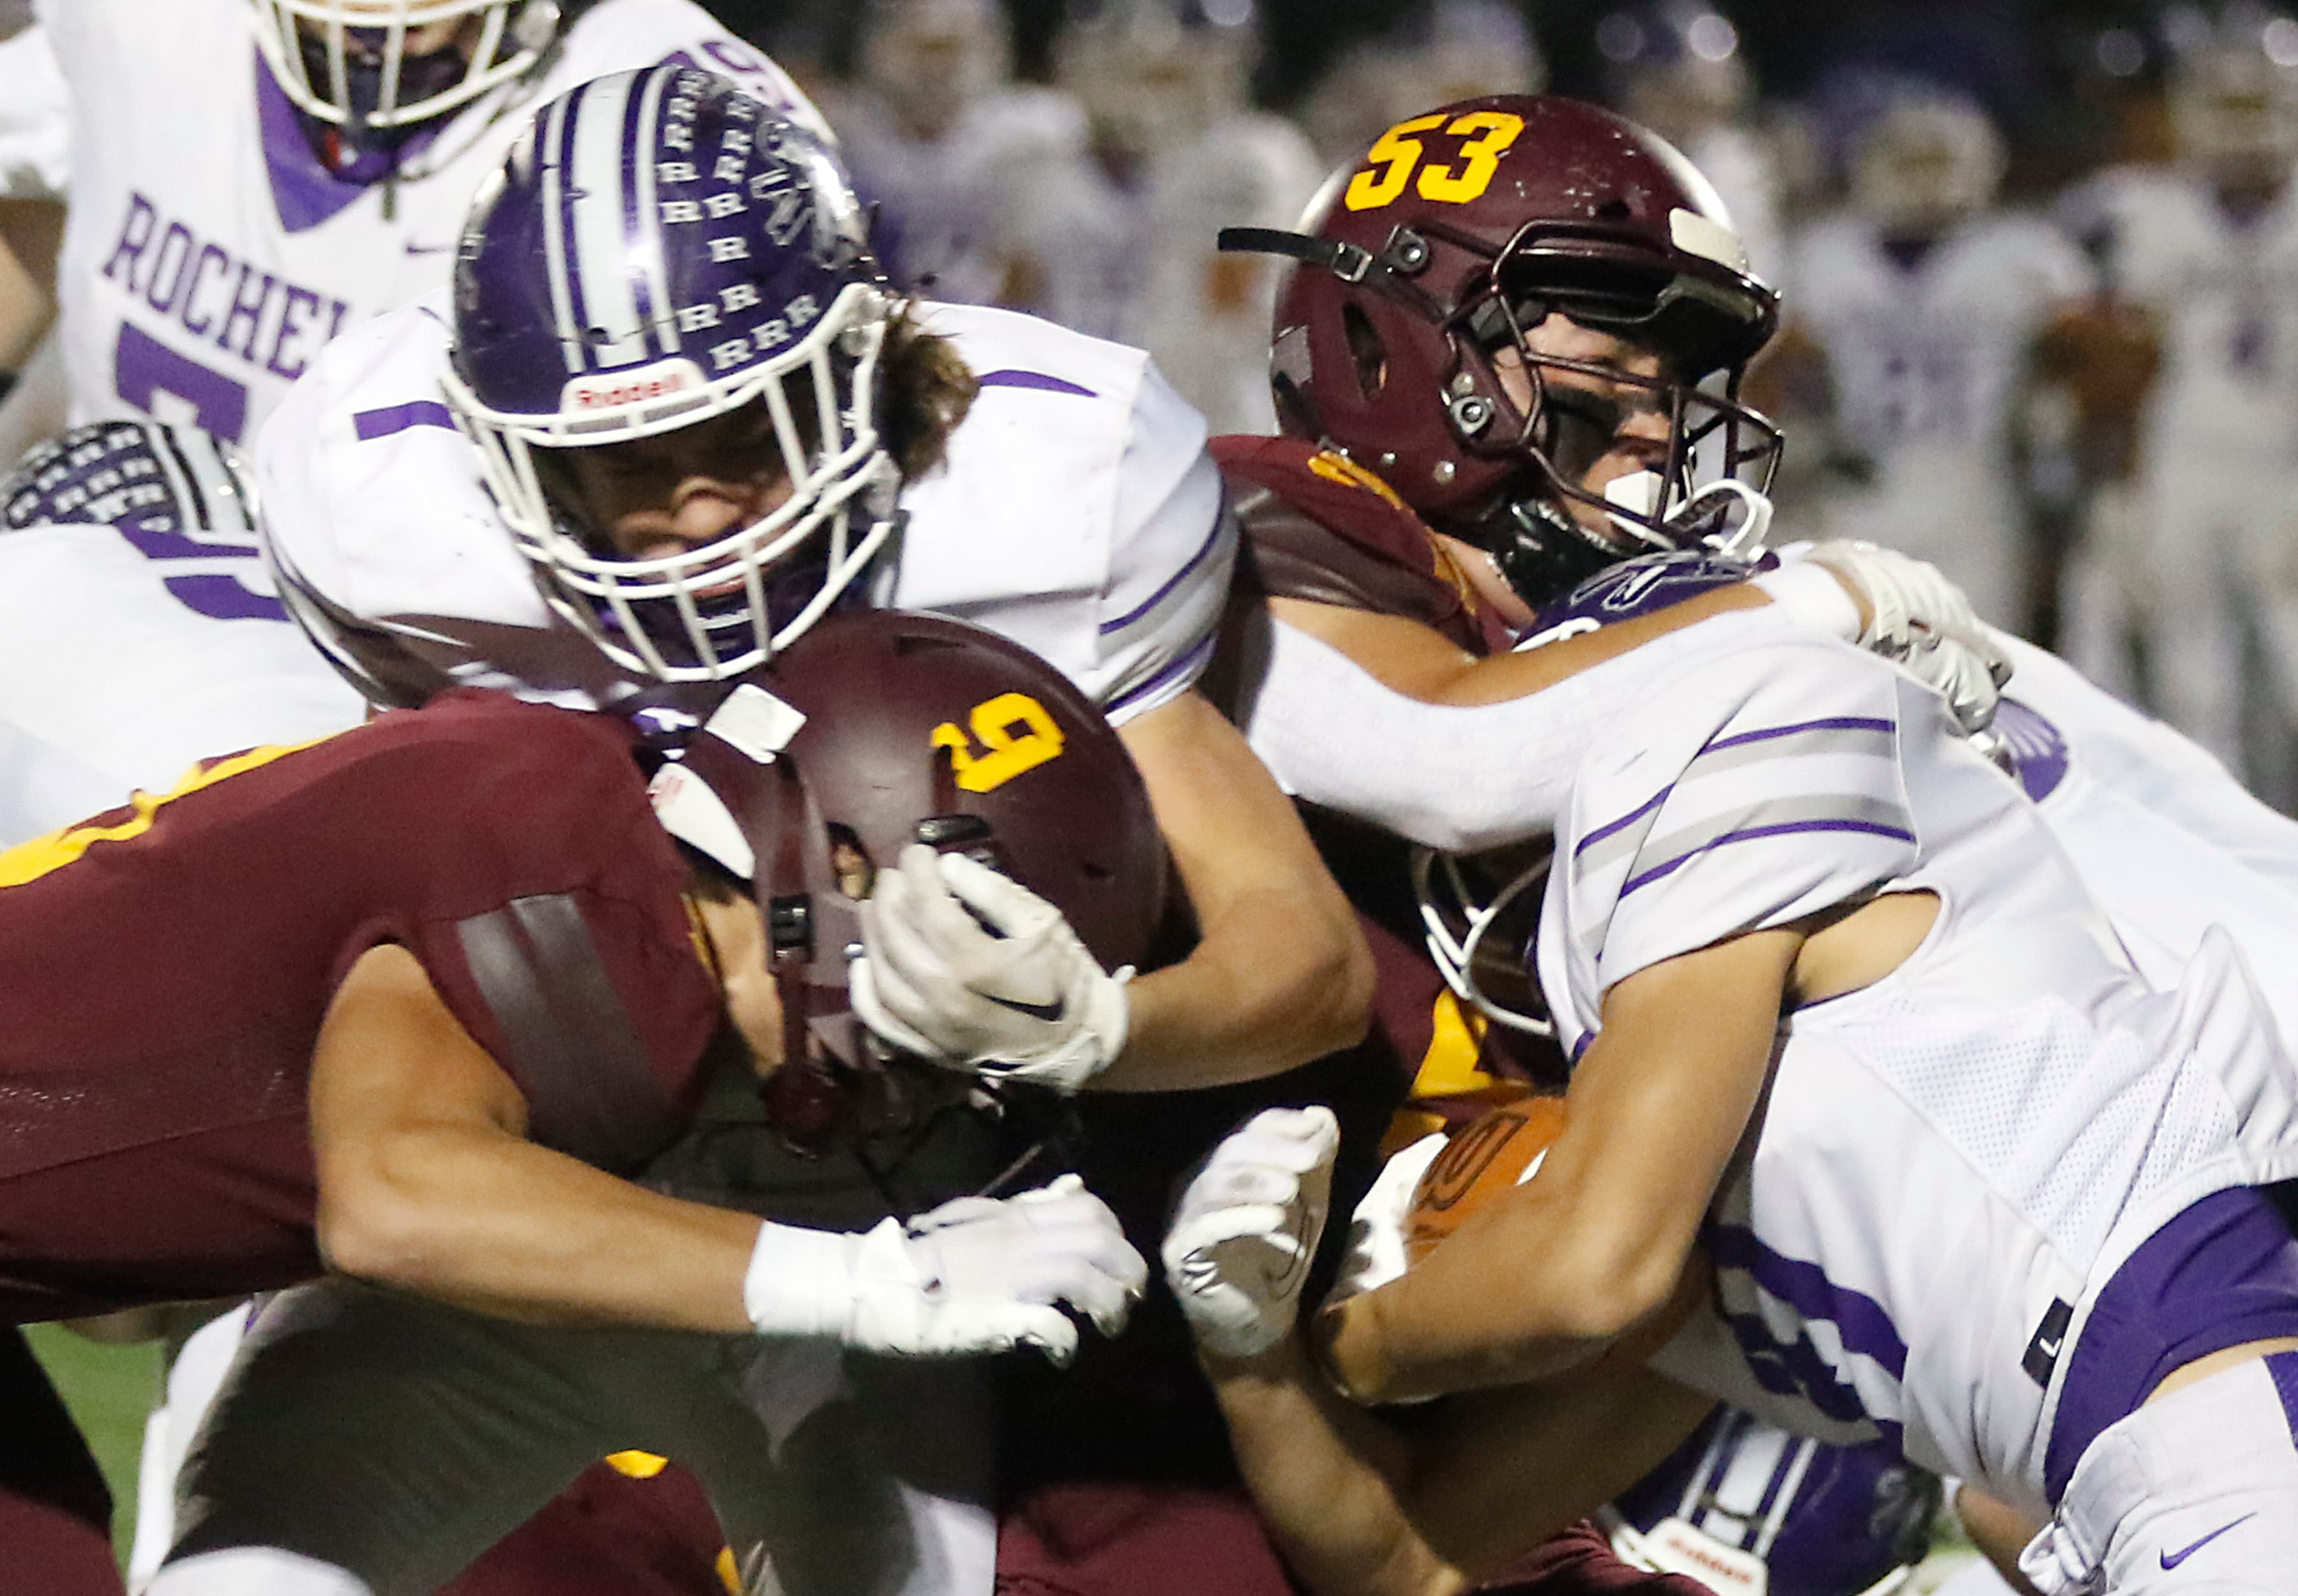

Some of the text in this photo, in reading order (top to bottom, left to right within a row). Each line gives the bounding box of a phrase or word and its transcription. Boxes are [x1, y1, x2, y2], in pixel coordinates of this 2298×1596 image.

[1344, 112, 1524, 211] 53
[658, 193, 749, 224] R R
[706, 237, 751, 263] R
[676, 283, 762, 333] R R
[709, 338, 754, 371] R
[750, 319, 792, 350] R
